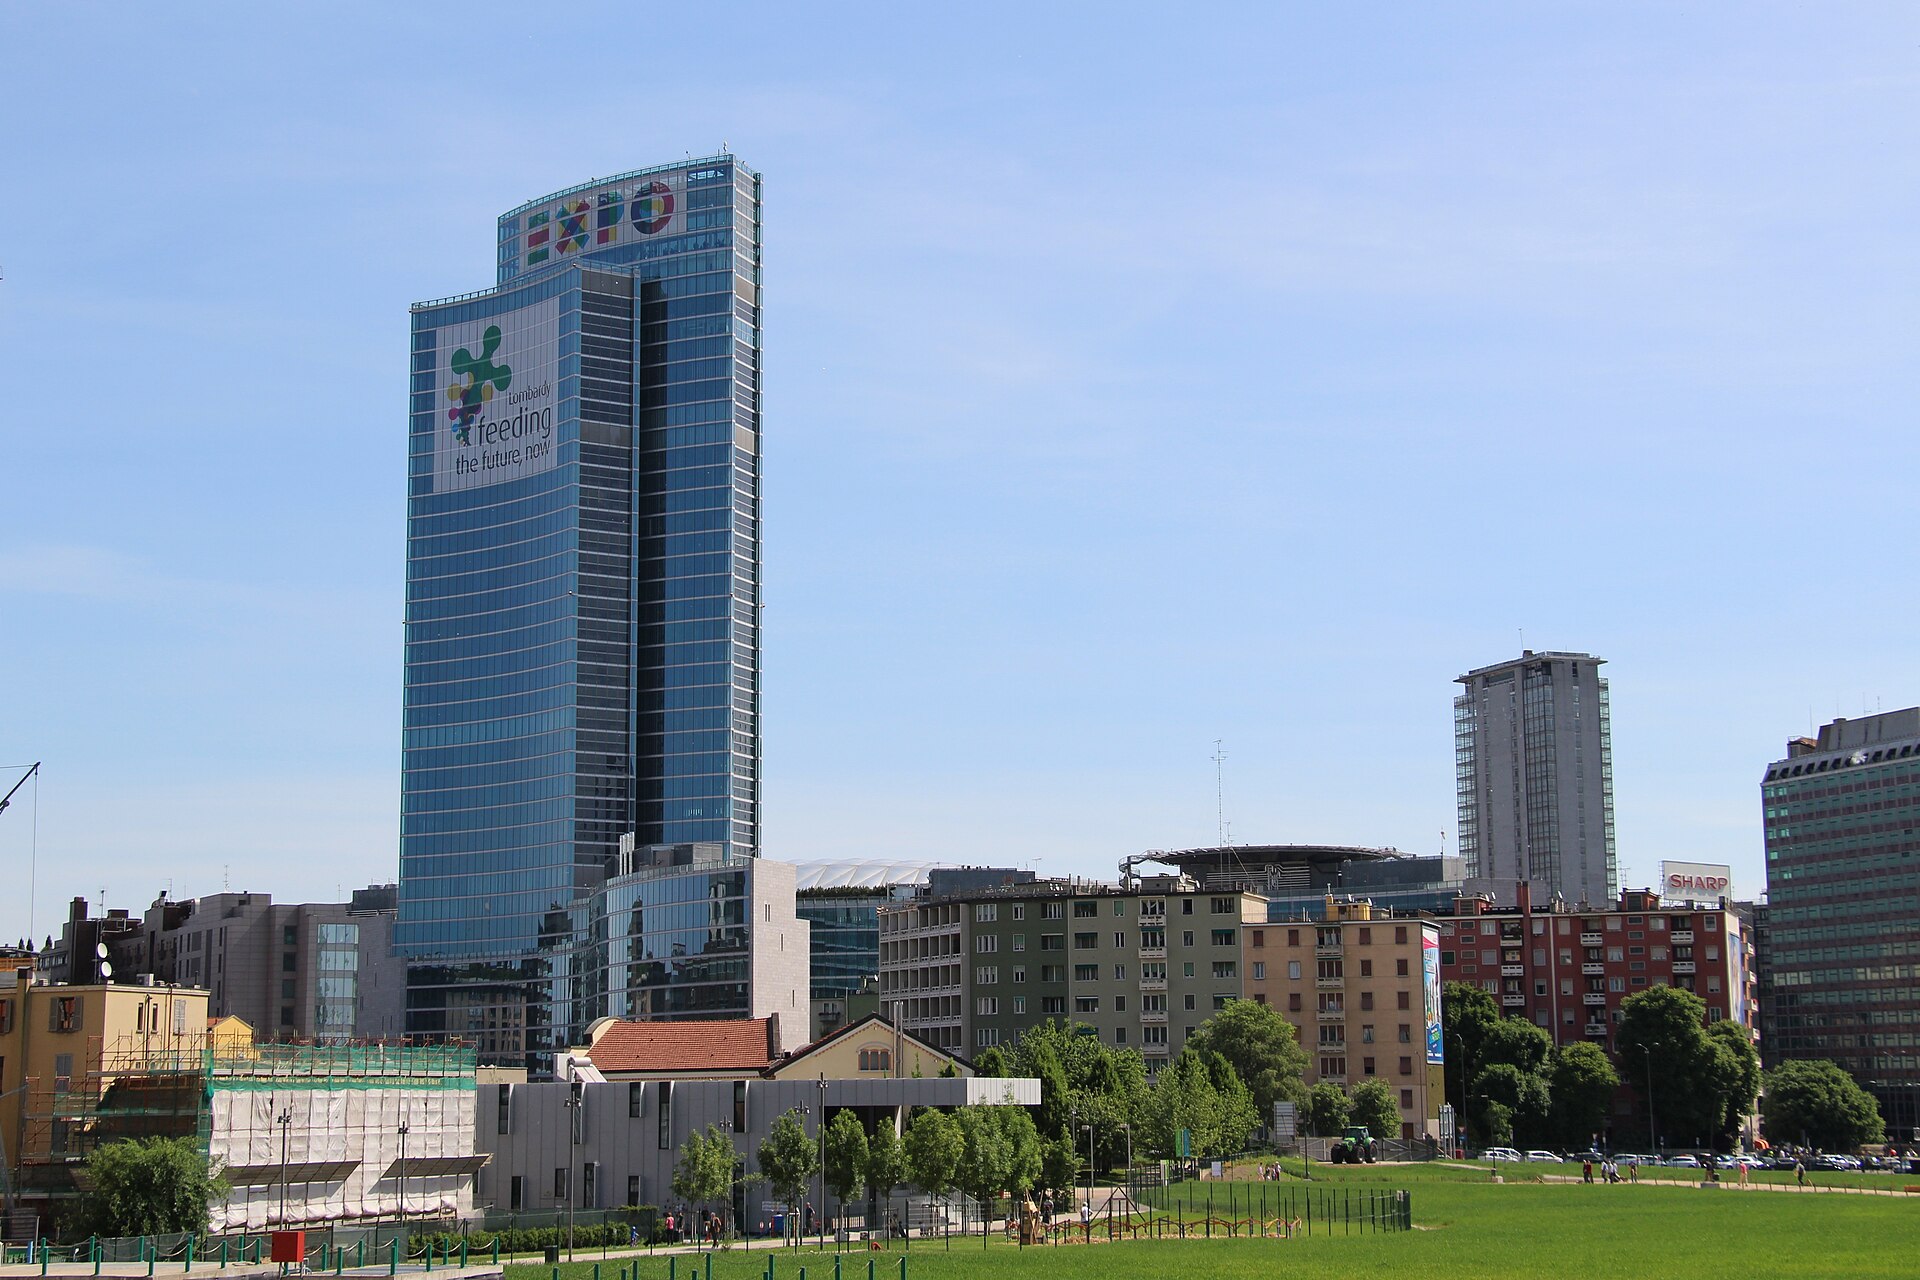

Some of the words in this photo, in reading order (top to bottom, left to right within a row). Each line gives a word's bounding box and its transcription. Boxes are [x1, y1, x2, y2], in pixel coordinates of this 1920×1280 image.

[528, 181, 675, 266] EXPO
[508, 380, 552, 406] Lombardy
[478, 406, 551, 447] feeding
[456, 454, 479, 475] the
[482, 449, 523, 471] future,
[525, 440, 551, 461] now
[1670, 874, 1728, 890] SHARP
